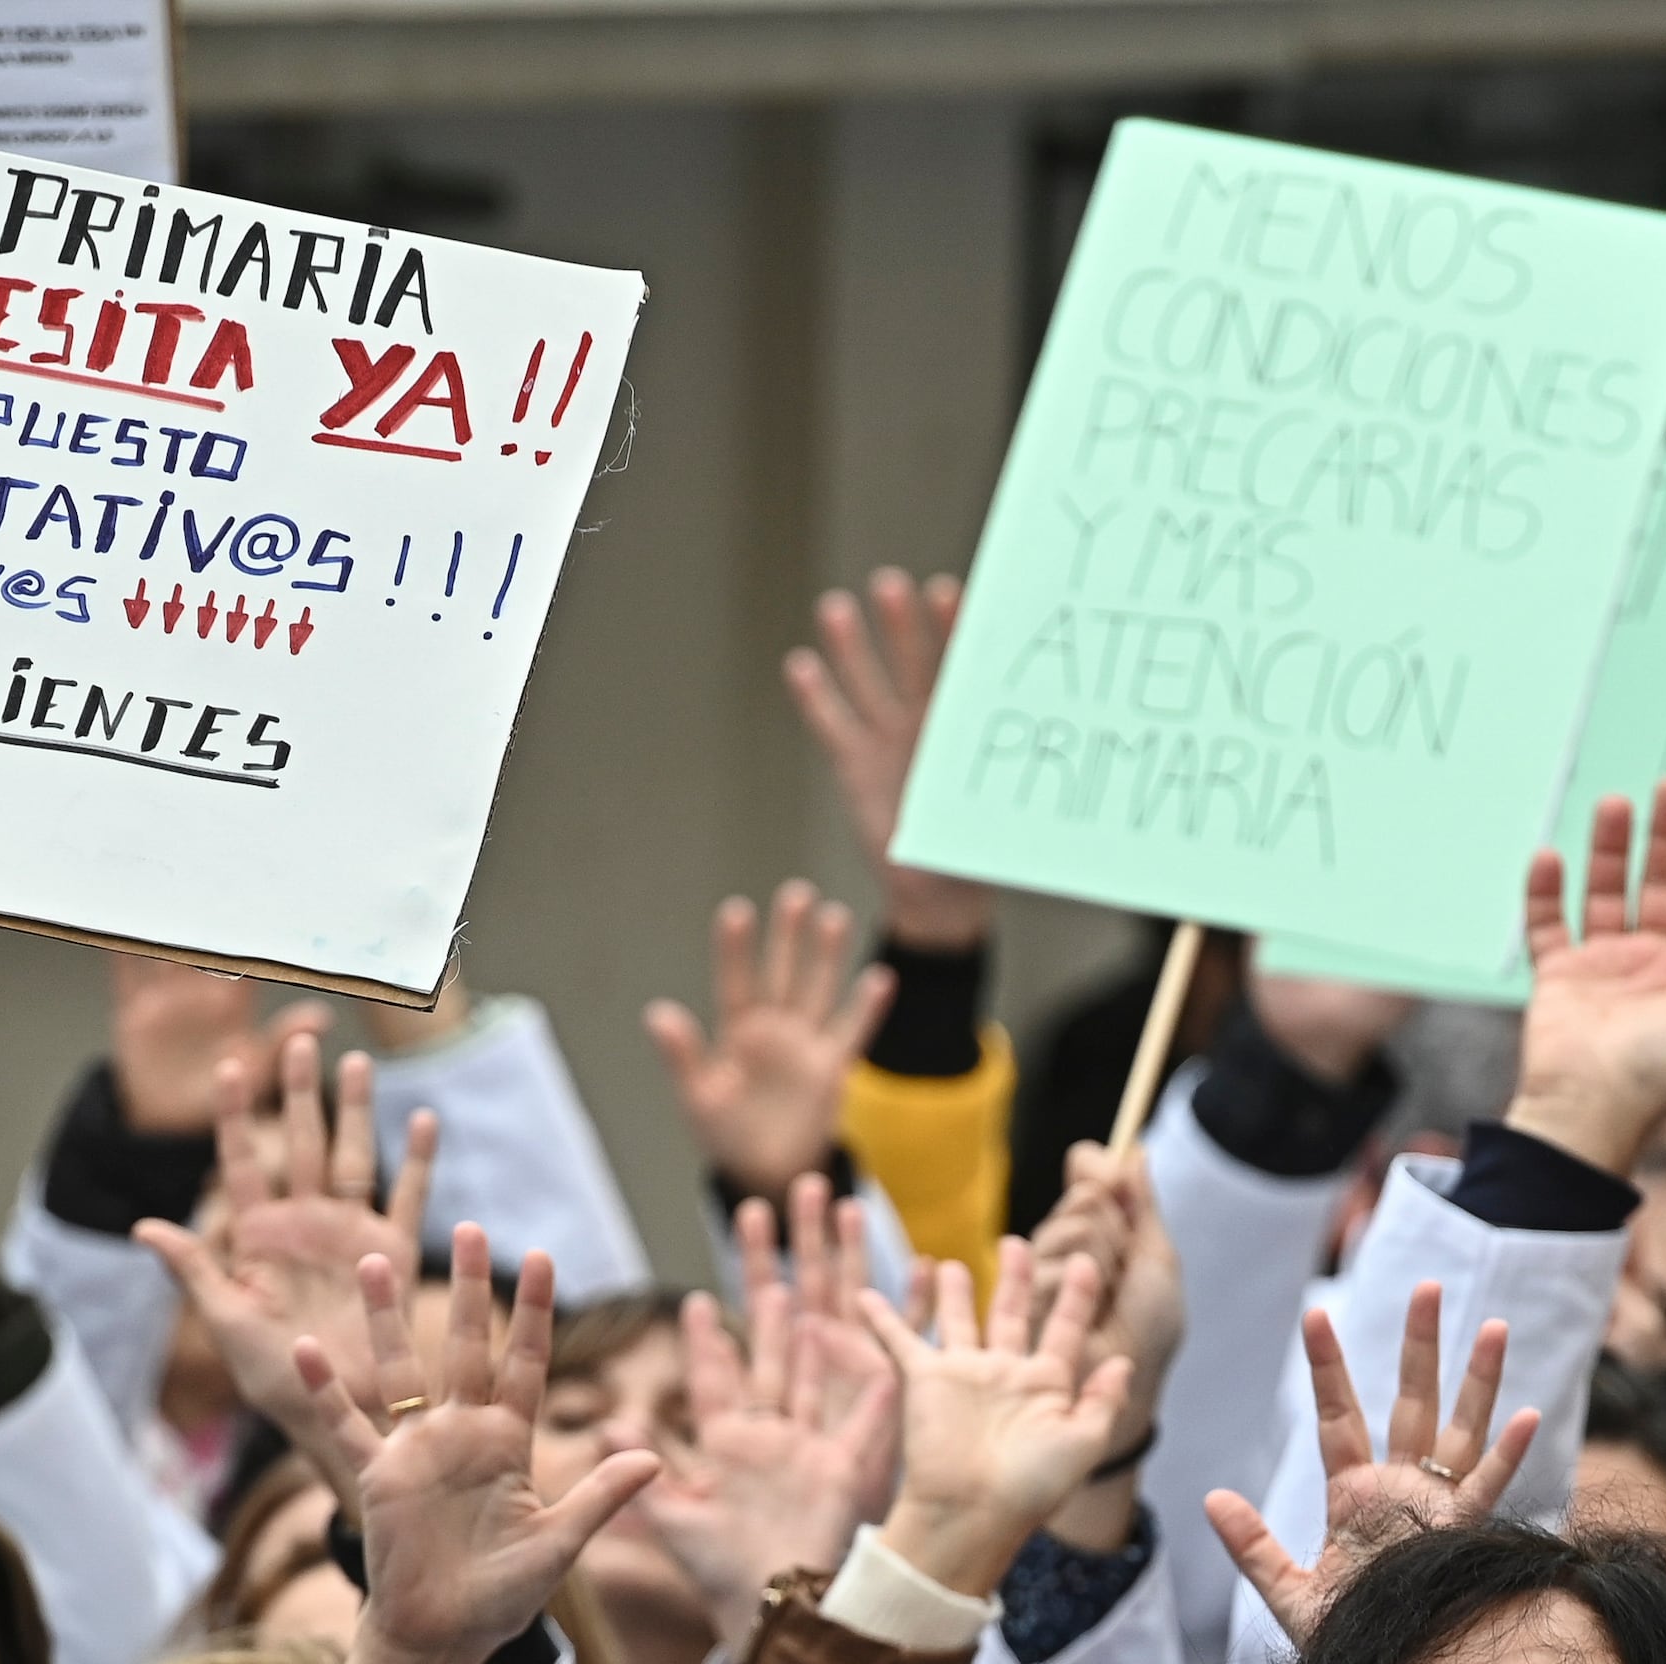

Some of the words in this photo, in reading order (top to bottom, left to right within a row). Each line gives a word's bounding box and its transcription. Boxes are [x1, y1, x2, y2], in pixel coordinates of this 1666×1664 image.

[1162, 159, 1540, 318] MENOS
[1102, 266, 1642, 460] CONDICIONES
[1055, 488, 1127, 595] Y
[1070, 374, 1546, 562] PRECARIAS
[1000, 602, 1472, 760] ATENCIÓN
[962, 706, 1338, 871] PRIMARIA
